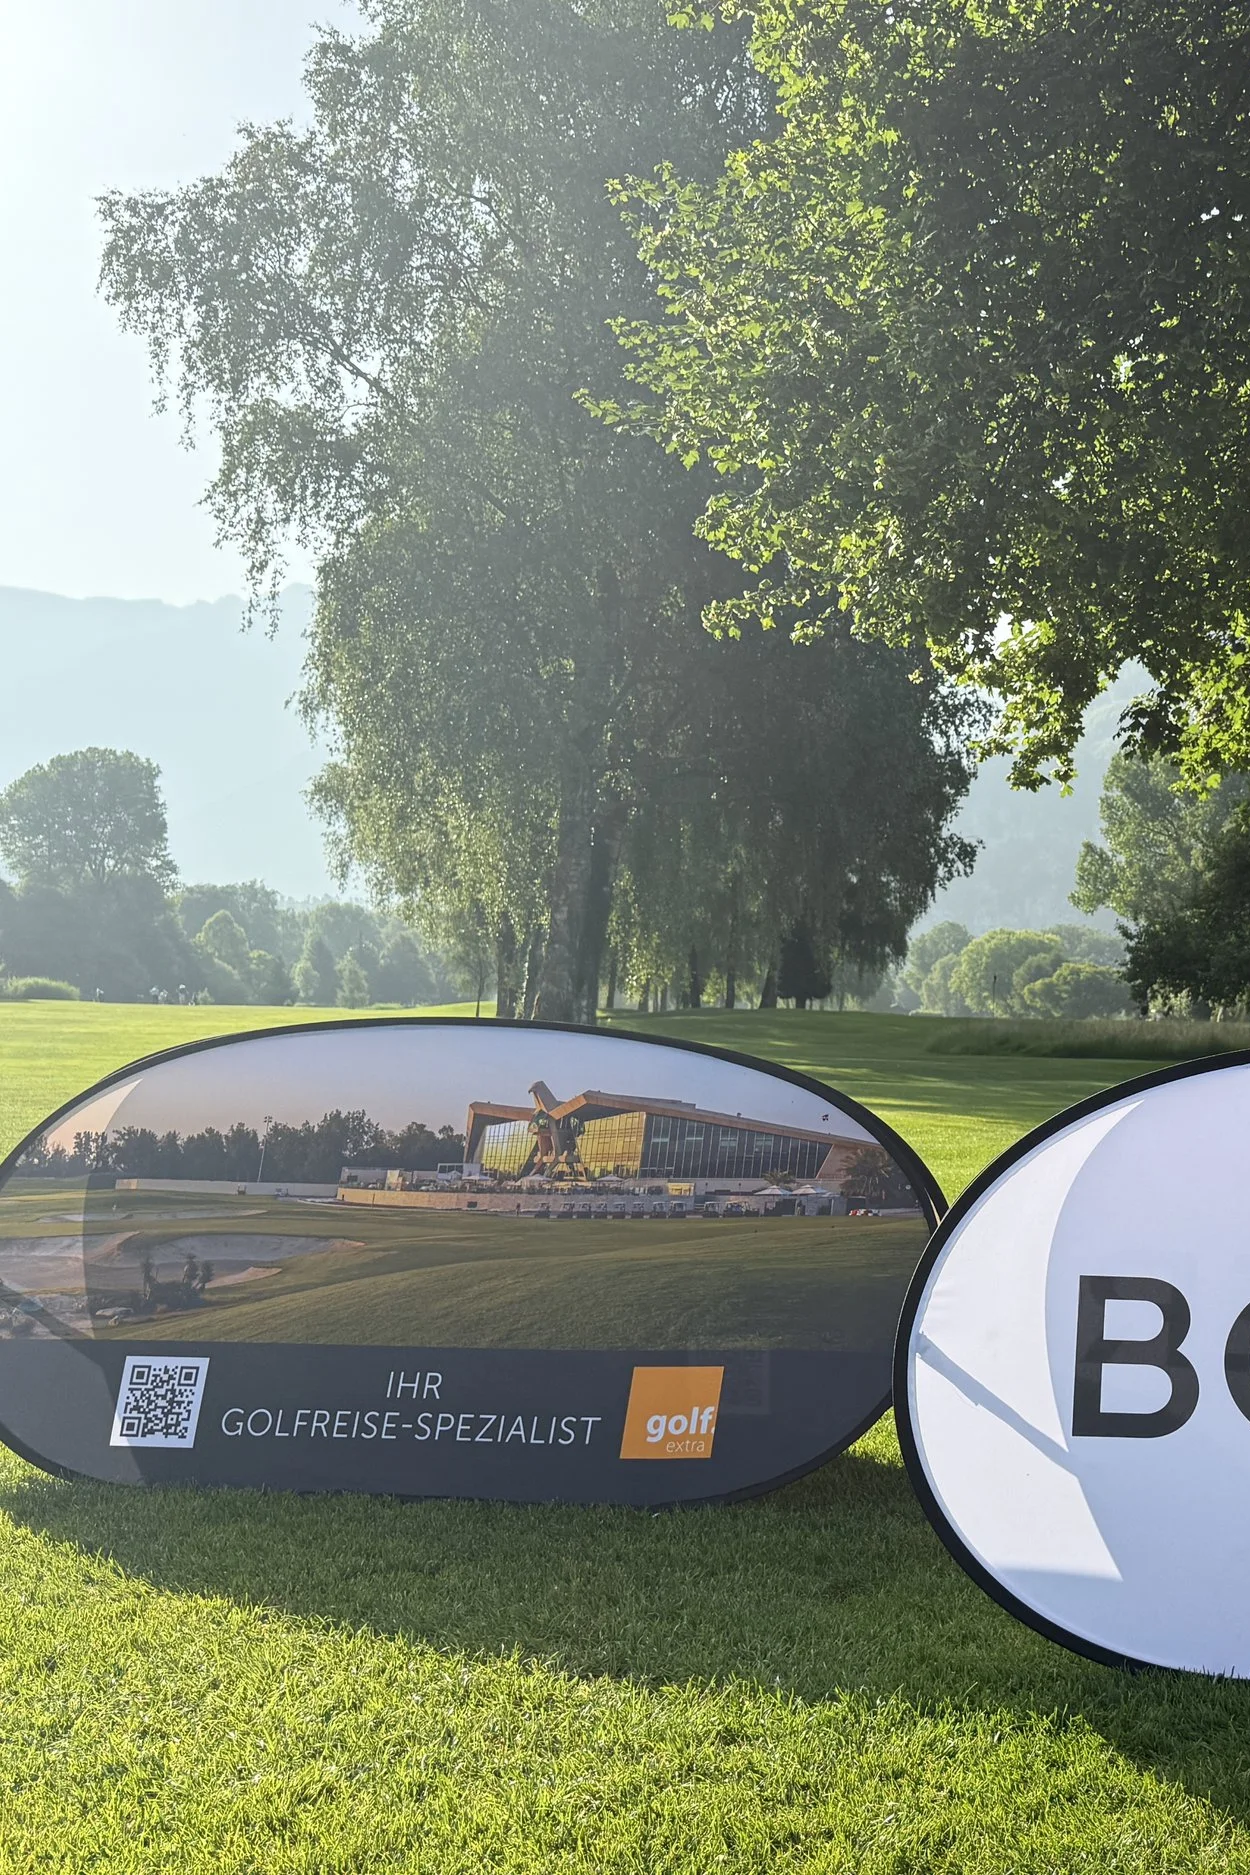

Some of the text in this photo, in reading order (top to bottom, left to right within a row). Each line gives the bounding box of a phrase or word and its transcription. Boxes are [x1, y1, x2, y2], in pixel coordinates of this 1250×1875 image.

[386, 1371, 443, 1400] IHR
[221, 1408, 602, 1445] GOLFREISE-SPEZIALIST
[666, 1440, 705, 1453] extra
